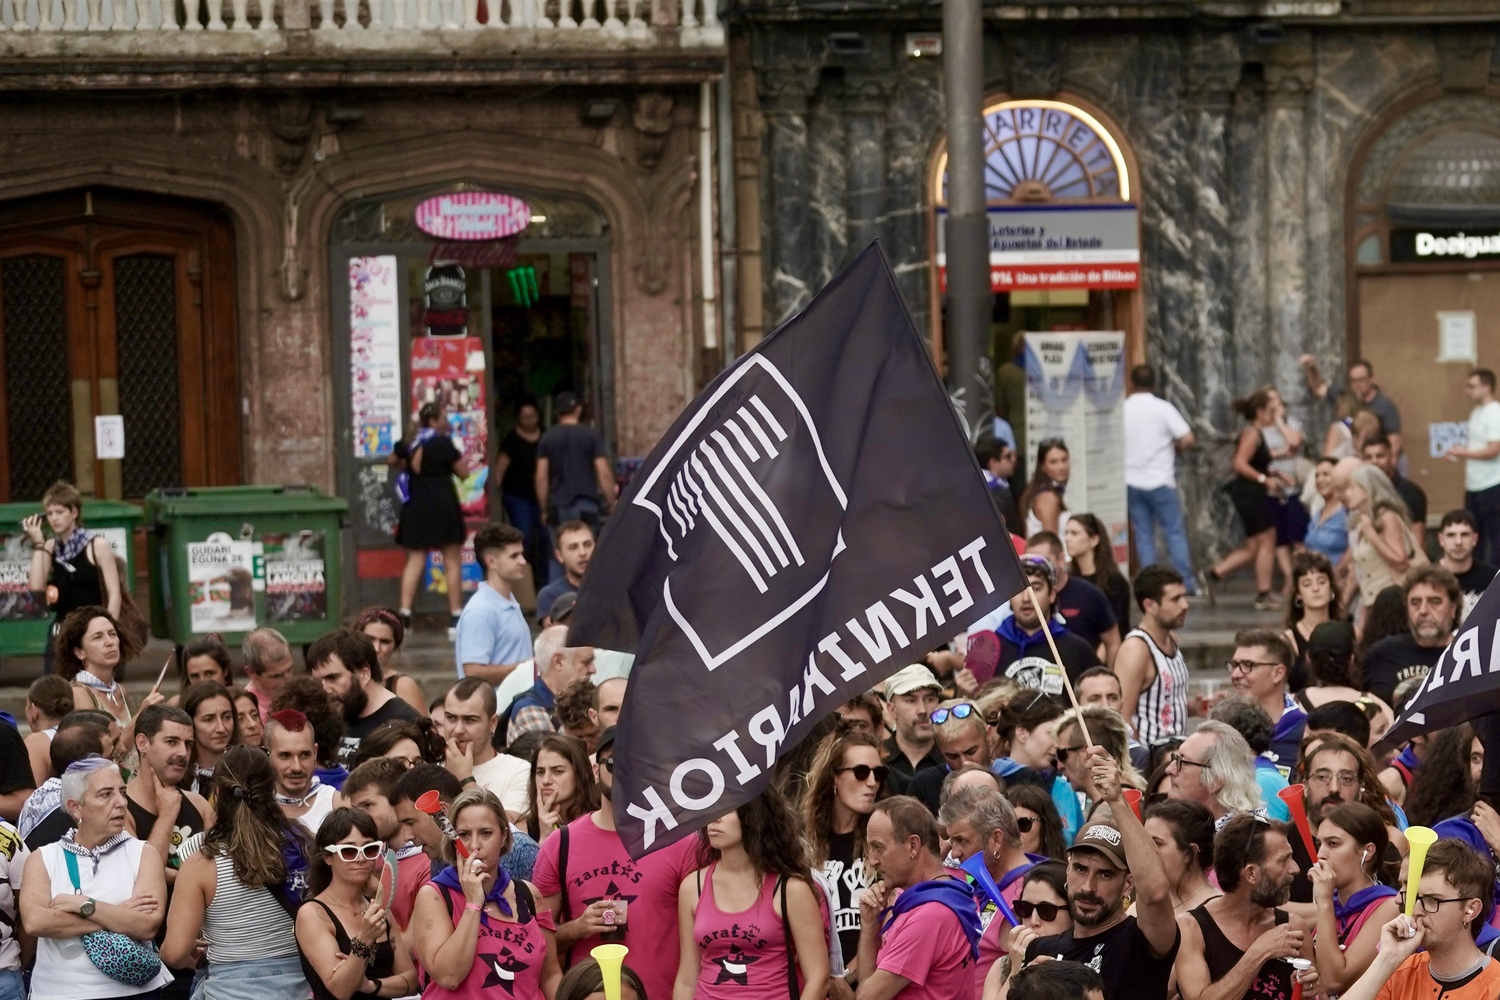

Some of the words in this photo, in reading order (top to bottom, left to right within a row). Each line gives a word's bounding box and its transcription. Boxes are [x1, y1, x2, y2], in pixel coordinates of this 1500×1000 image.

[1046, 238, 1062, 249] del
[1066, 238, 1102, 249] Estado
[1016, 271, 1036, 284] Una
[1039, 269, 1084, 284] tradición
[1087, 270, 1100, 283] de
[1102, 269, 1137, 283] Bilbao
[192, 546, 231, 554] GUDARI
[192, 555, 228, 563] EGUNA
[232, 554, 243, 562] 26
[1396, 665, 1433, 681] FREED
